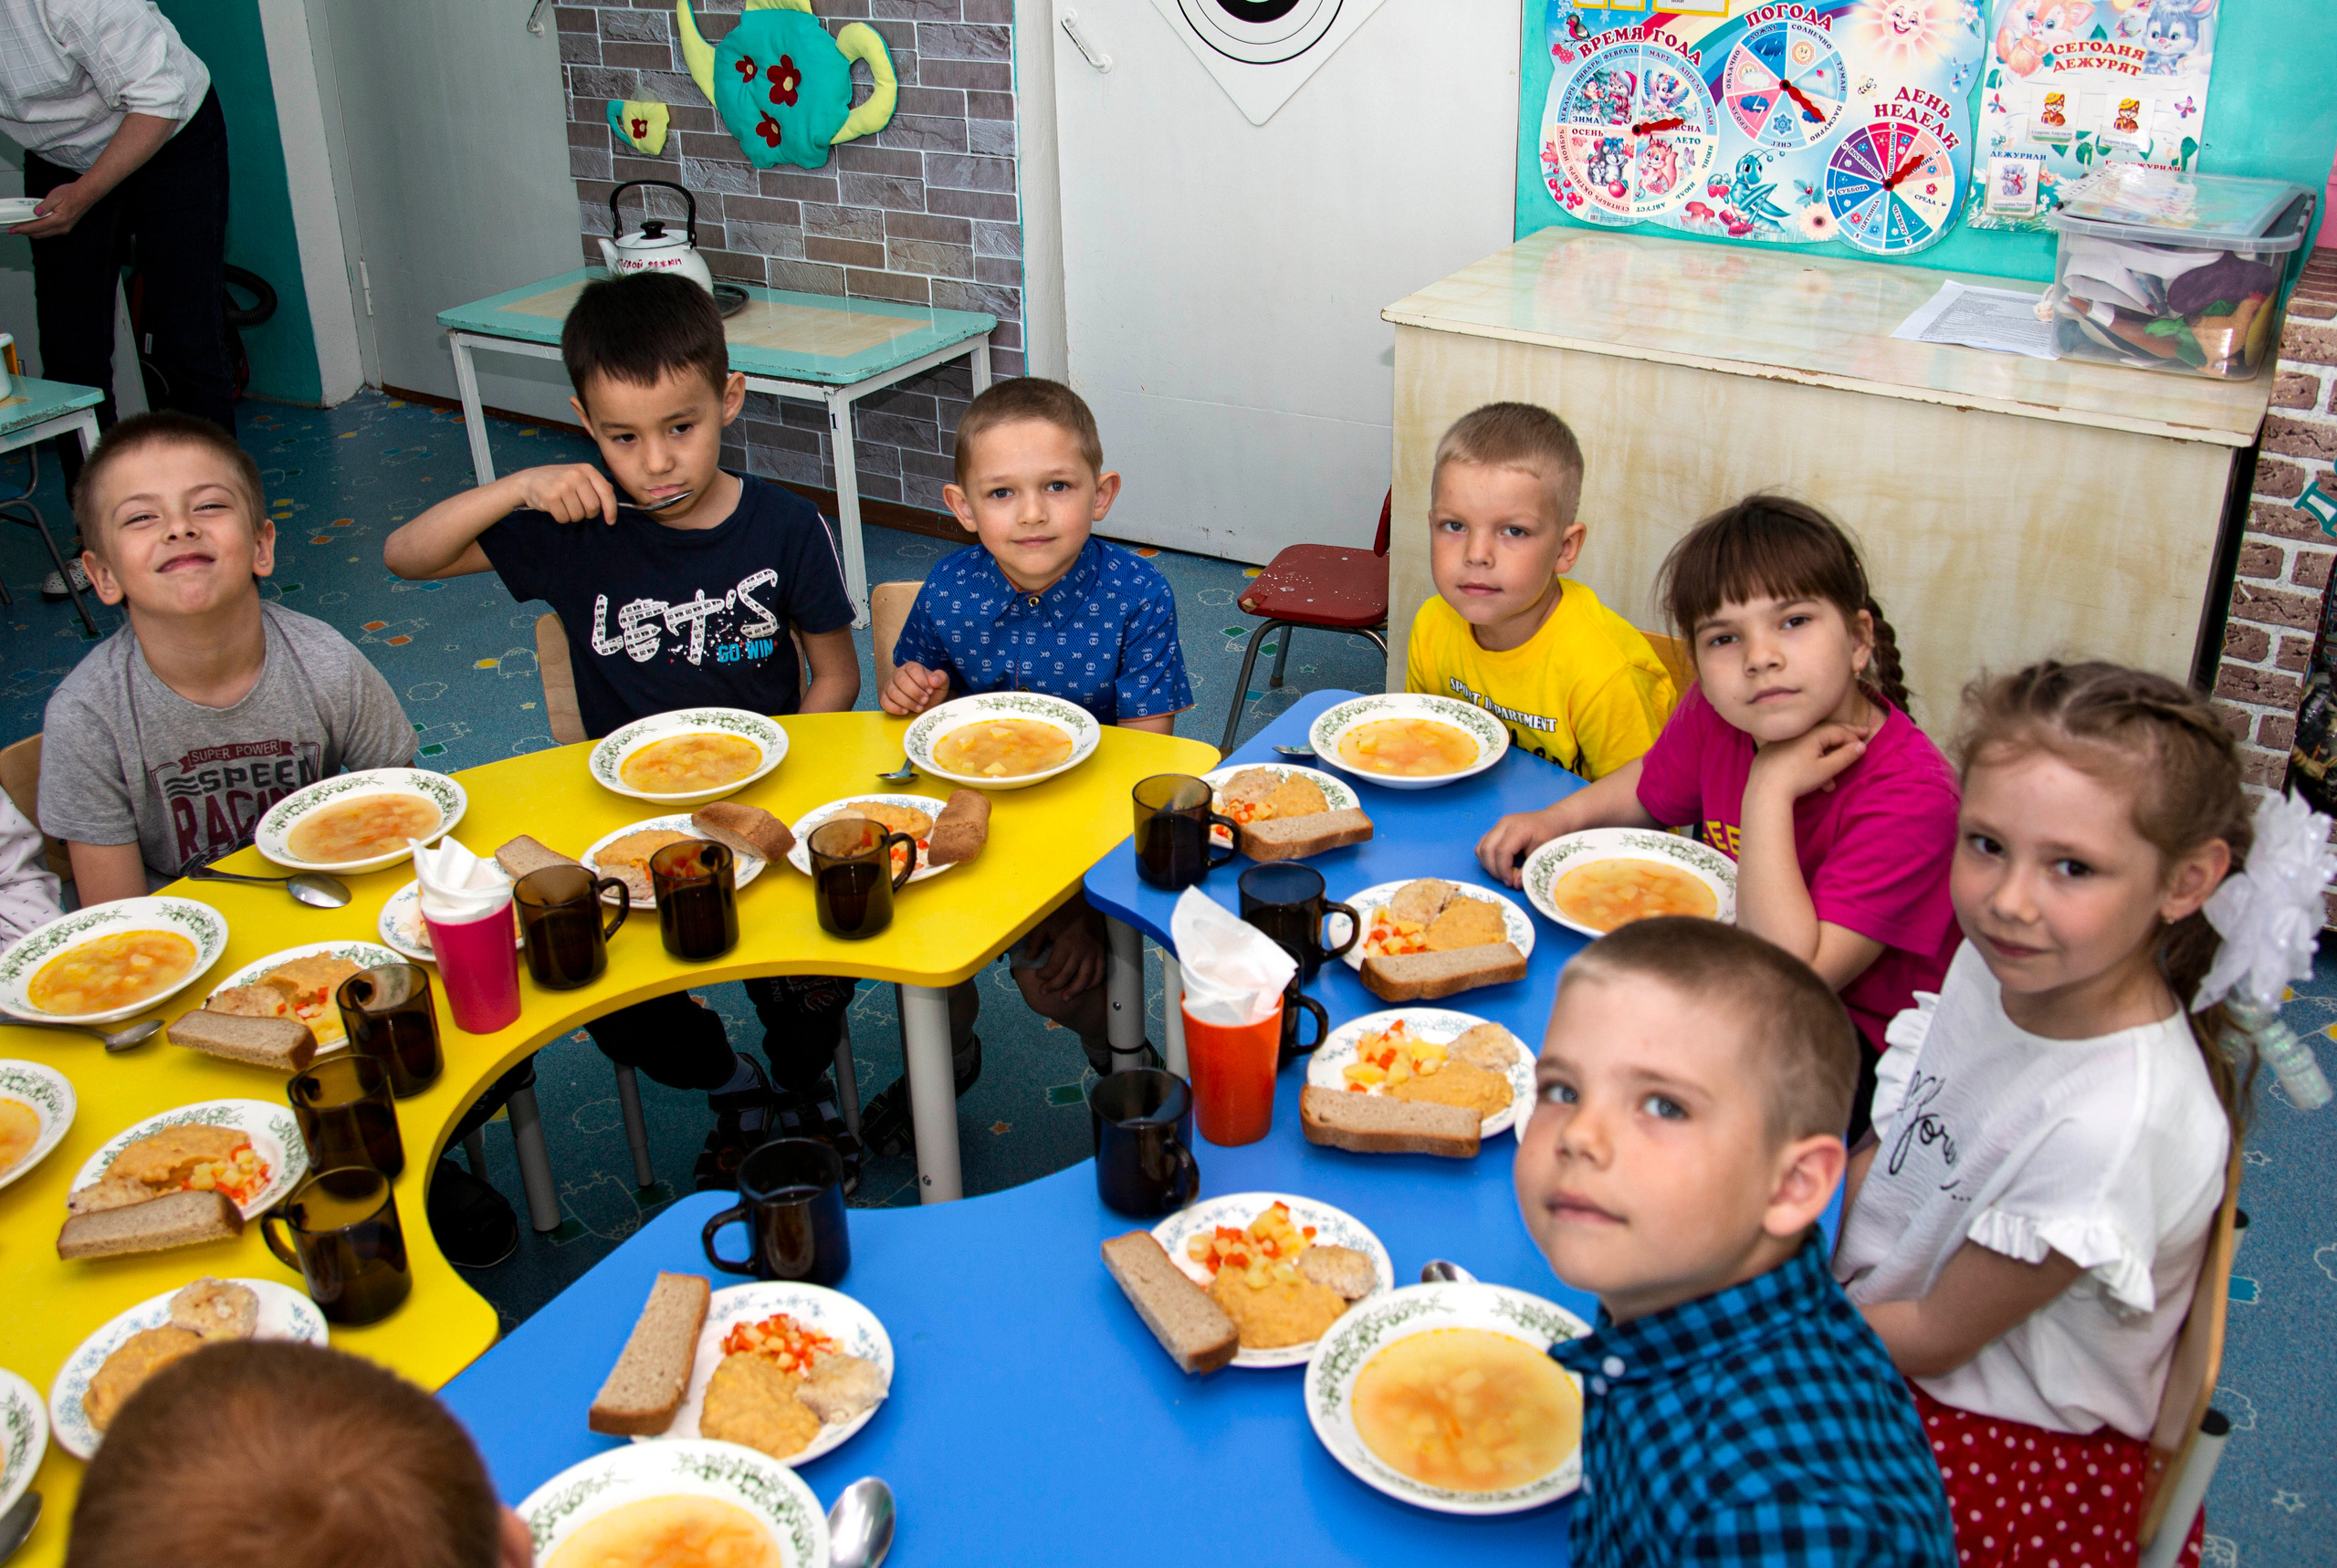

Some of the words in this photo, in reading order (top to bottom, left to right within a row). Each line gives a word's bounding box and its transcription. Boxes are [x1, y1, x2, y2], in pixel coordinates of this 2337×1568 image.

[1745, 5, 1832, 32] ПОГОДА
[1750, 24, 1777, 41] ДОЖДЬ
[1792, 24, 1832, 49] СОЛНЕЧНО
[1578, 26, 1643, 58] ВРЕМЯ
[1653, 28, 1702, 66] ГОДА
[1604, 47, 1639, 59] ФЕВРАЛЬ
[1650, 49, 1671, 62] МАРТ
[2053, 41, 2145, 62] СЕГОДНЯ
[1576, 59, 1600, 83] ЯНВАРЬ
[1726, 49, 1741, 89] ОБЛАЧНО
[1837, 61, 1846, 91] ТУМАН
[2053, 57, 2142, 77] ДЕЖУРЯТ
[1679, 66, 1703, 94] АПРЕЛЬ
[1560, 86, 1576, 122] ДЕКАБРЬ
[1895, 86, 1951, 120] ДЕНЬ
[1572, 116, 1599, 124] ЗИМА
[1706, 107, 1714, 126] МАЙ
[1732, 106, 1749, 131] ГРОЗА
[1810, 105, 1842, 141] ПАСМУРНО
[1874, 104, 1960, 151] НЕДЕЛИ
[1559, 129, 1569, 162] НОЯБРЬ
[1571, 129, 1604, 137] ОСЕНЬ
[1675, 136, 1701, 145] ЛЕТО
[1702, 145, 1713, 170] ИЮНЬ
[1850, 149, 1882, 181] ВОСКРЕСЕНЬЕ
[1990, 151, 2047, 162] ДЕЖУРИЛИ
[1569, 165, 1593, 195] ОКТЯБРЬ
[1675, 182, 1696, 200] ИЮЛЬ
[1838, 184, 1869, 195] СУББОТА
[1594, 194, 1630, 213] СЕНТЯБРЬ
[1636, 201, 1666, 213] АВГУСТ
[1914, 194, 1936, 205] СРЕДА
[1860, 200, 1880, 231] ПЯТНИЦА
[1893, 204, 1908, 235] ЧЕТВЕРГ
[592, 569, 779, 666] LET'S
[718, 643, 740, 663] GO
[745, 638, 774, 660] WIN
[191, 747, 231, 763] SUPER
[236, 741, 278, 758] POWER
